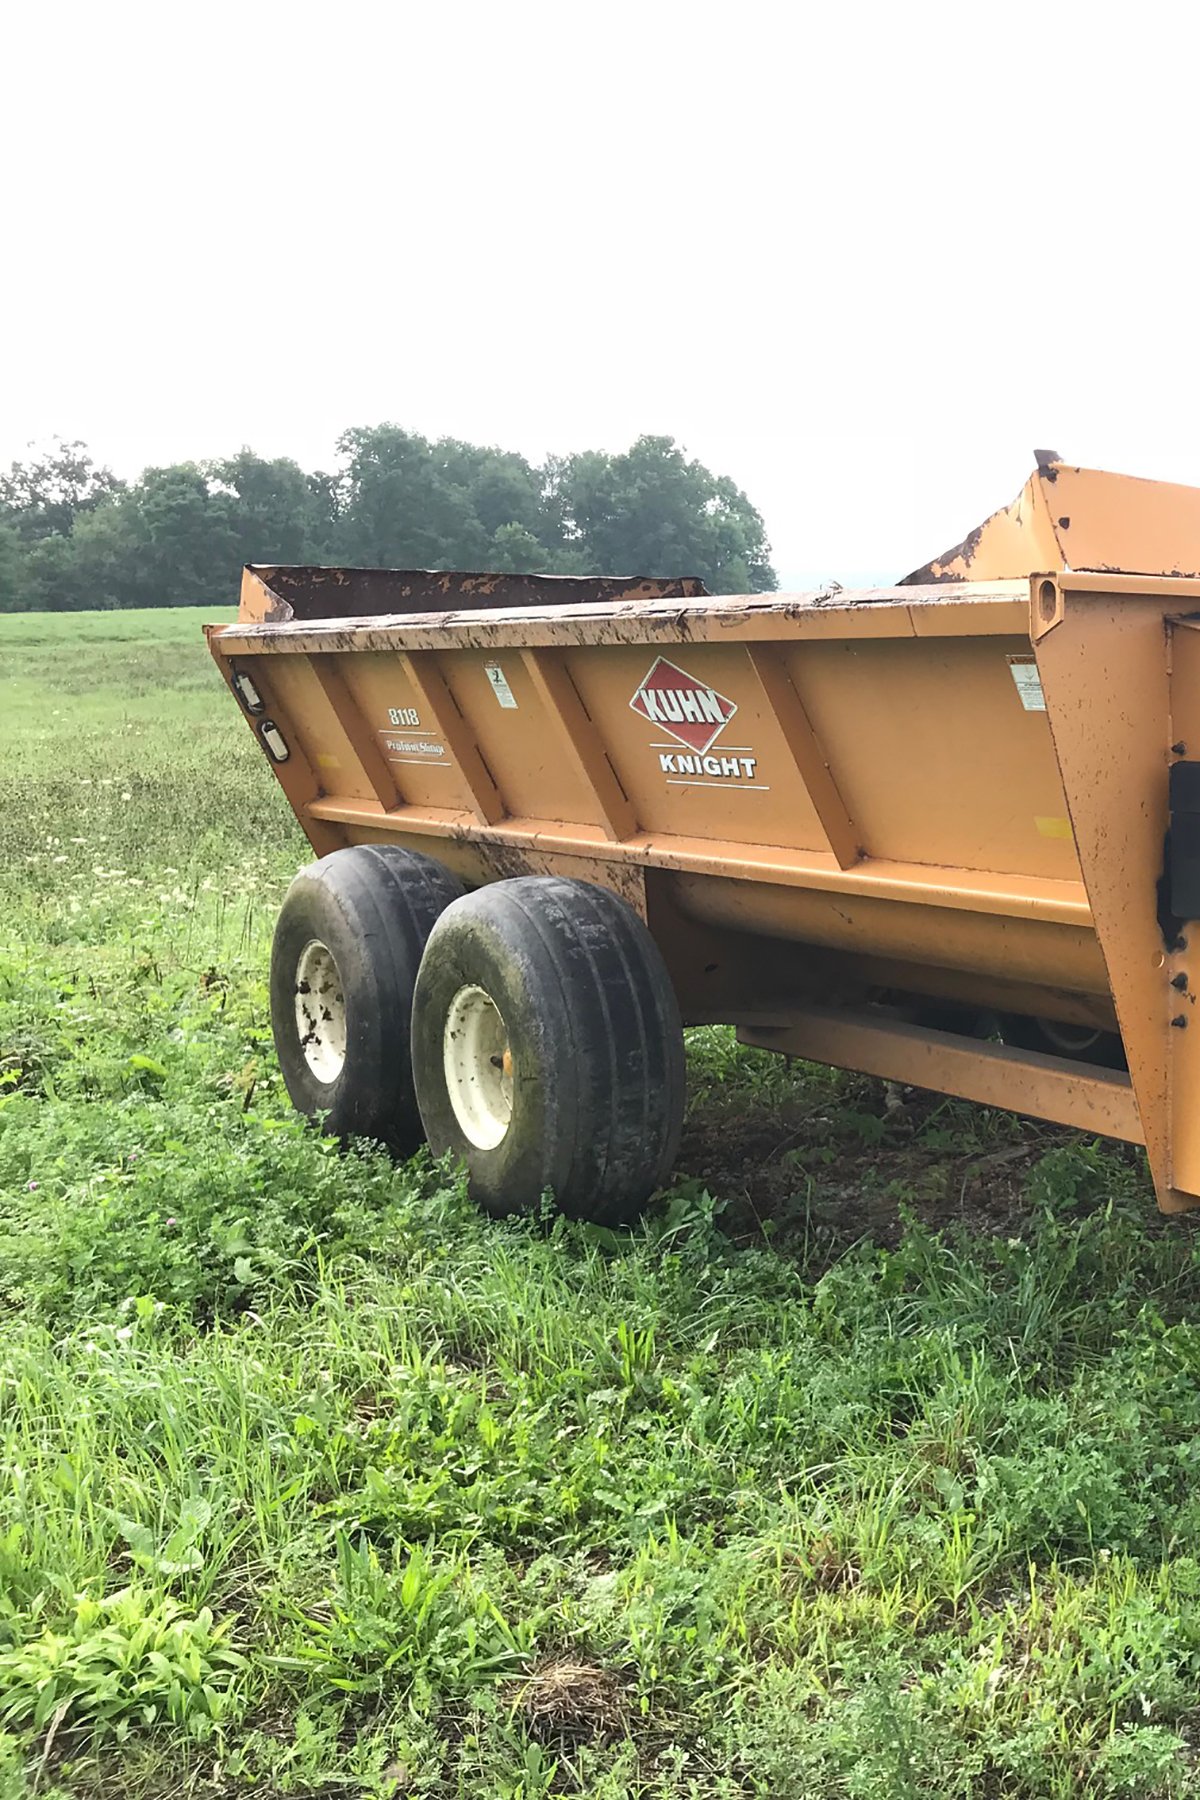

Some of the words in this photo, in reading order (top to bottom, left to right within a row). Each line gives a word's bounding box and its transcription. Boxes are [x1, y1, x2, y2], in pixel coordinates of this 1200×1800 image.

[388, 708, 420, 726] 8118
[639, 688, 727, 724] KUHN
[659, 754, 757, 778] KNIGHT
